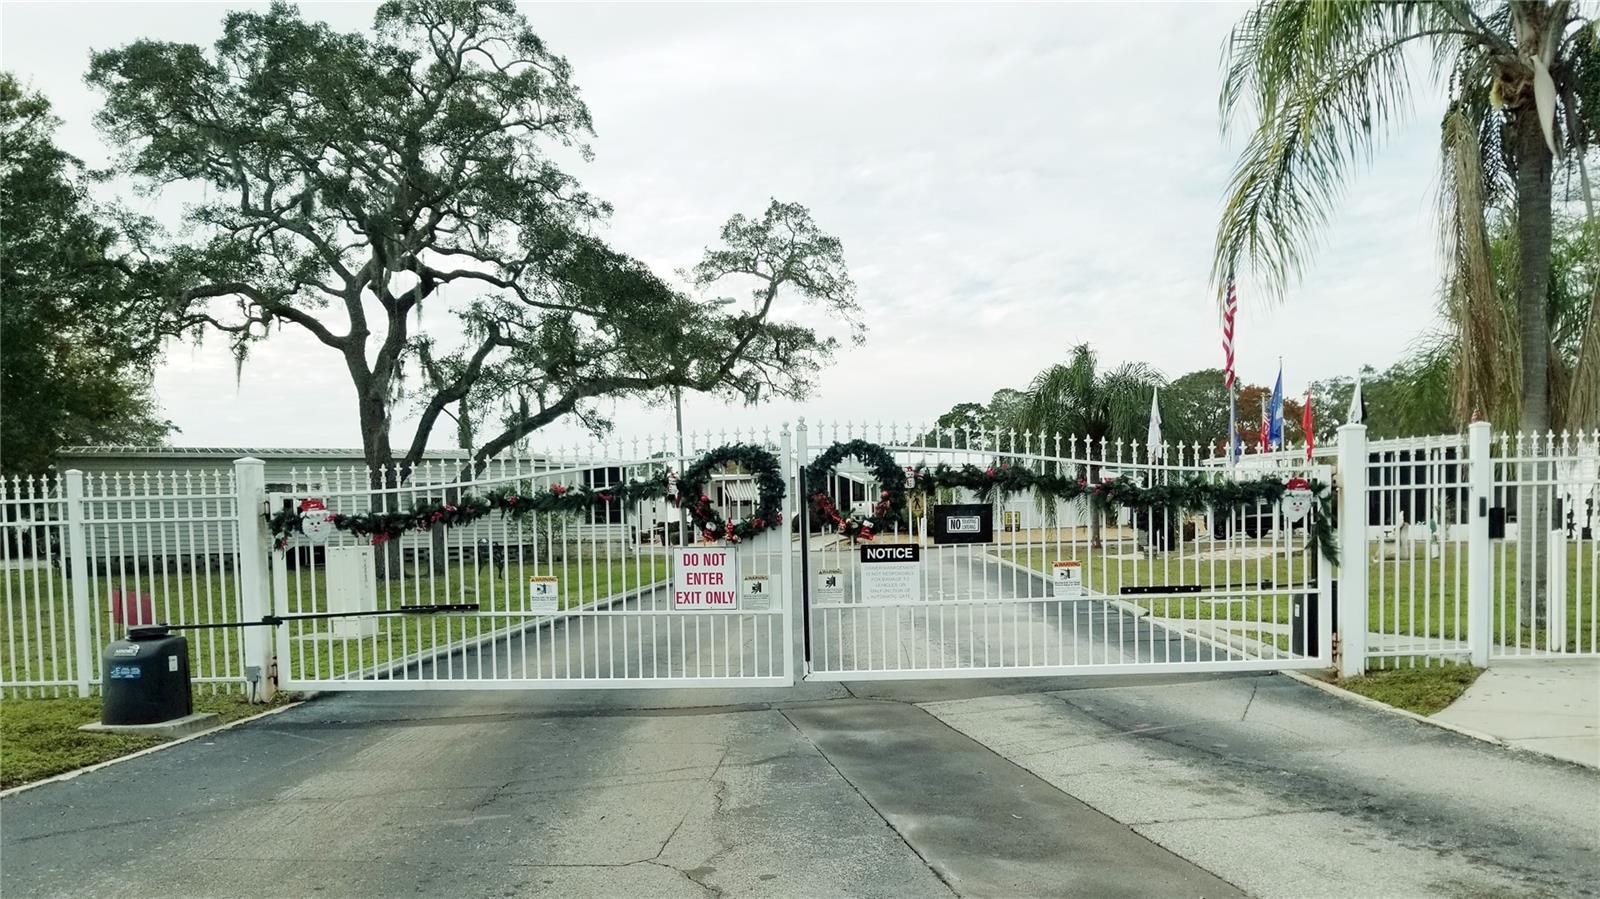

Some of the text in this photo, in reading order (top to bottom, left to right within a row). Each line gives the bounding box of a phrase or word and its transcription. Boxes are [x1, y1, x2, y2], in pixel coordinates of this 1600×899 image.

[951, 519, 961, 529] NO
[683, 553, 726, 566] DO NOT
[867, 548, 913, 559] NOTICE
[686, 572, 723, 585] ENTER
[676, 592, 701, 604] EXIT
[706, 592, 734, 604] ONLY
